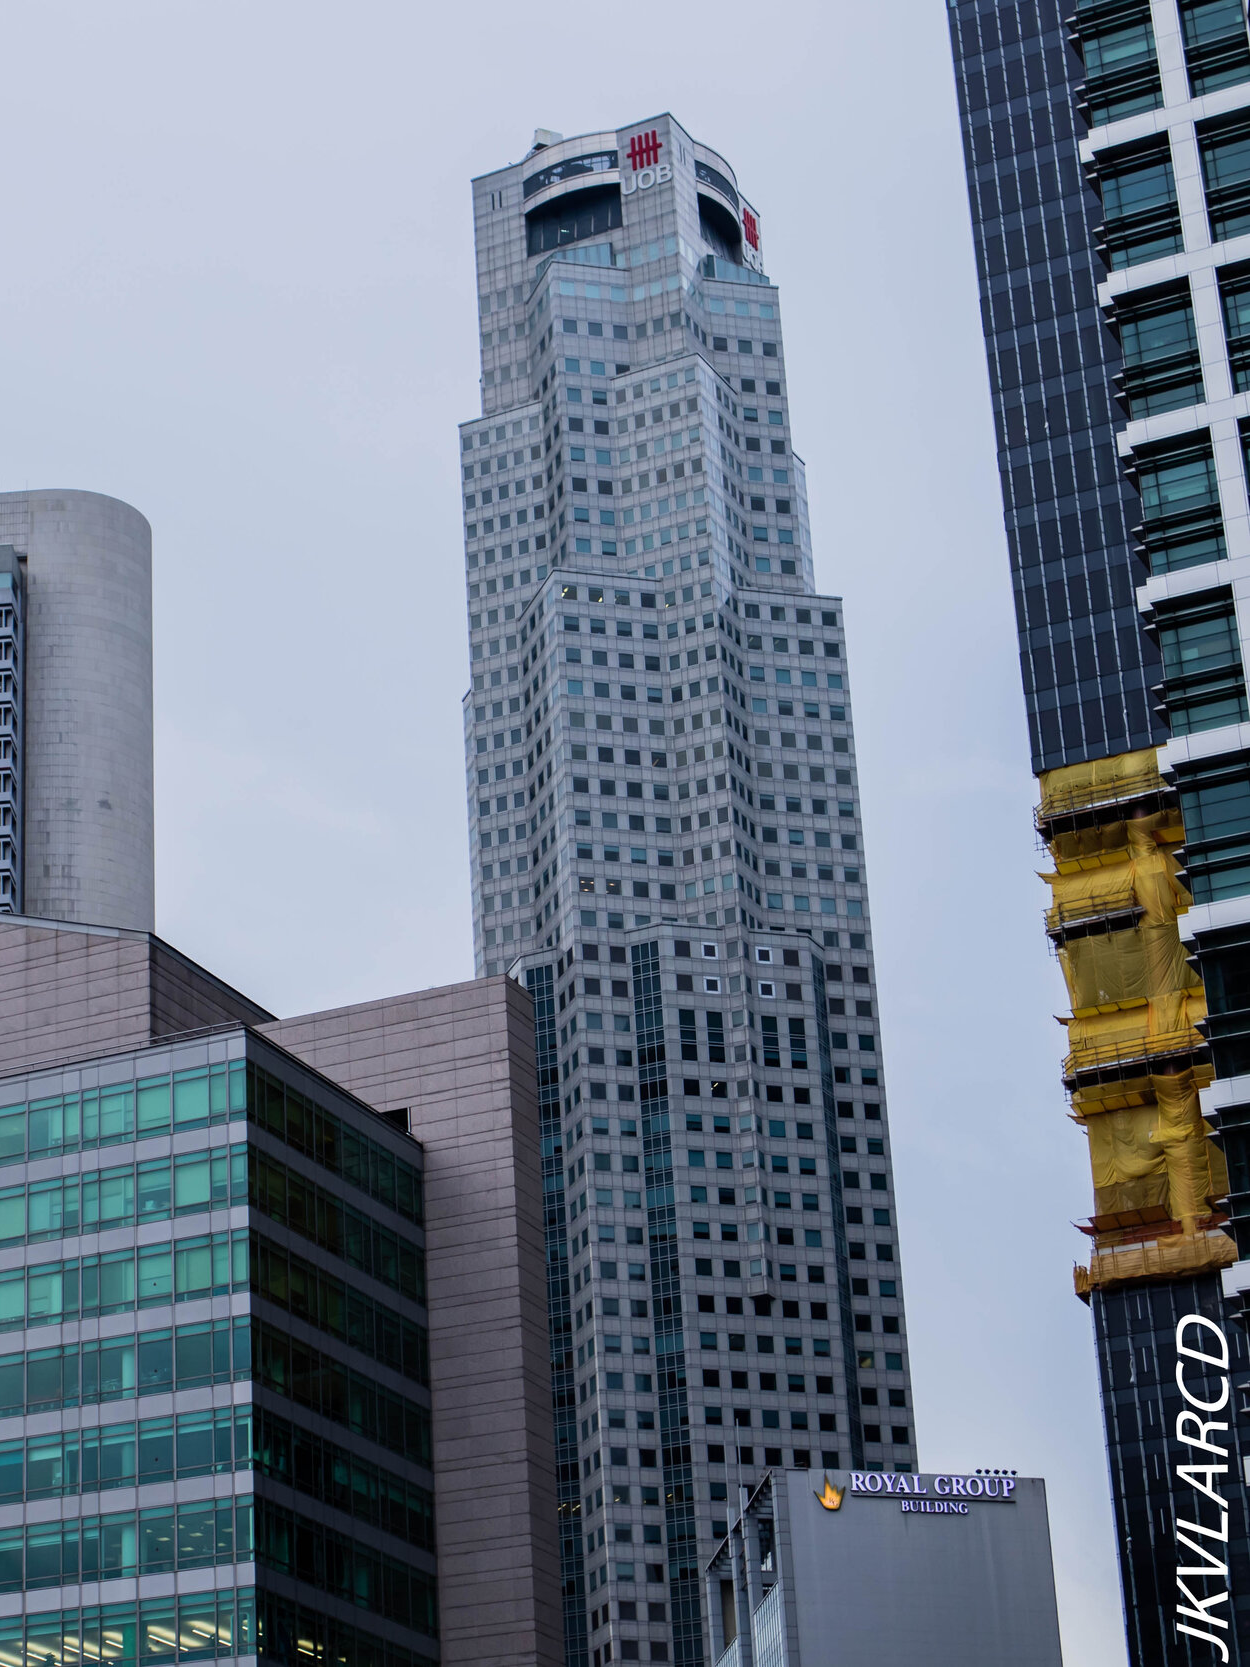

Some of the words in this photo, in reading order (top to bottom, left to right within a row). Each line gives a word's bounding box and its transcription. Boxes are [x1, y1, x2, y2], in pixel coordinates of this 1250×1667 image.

[621, 164, 673, 196] UOB
[850, 1472, 928, 1494] ROYAL
[934, 1477, 1016, 1498] GROUP
[901, 1500, 969, 1515] BUILDING
